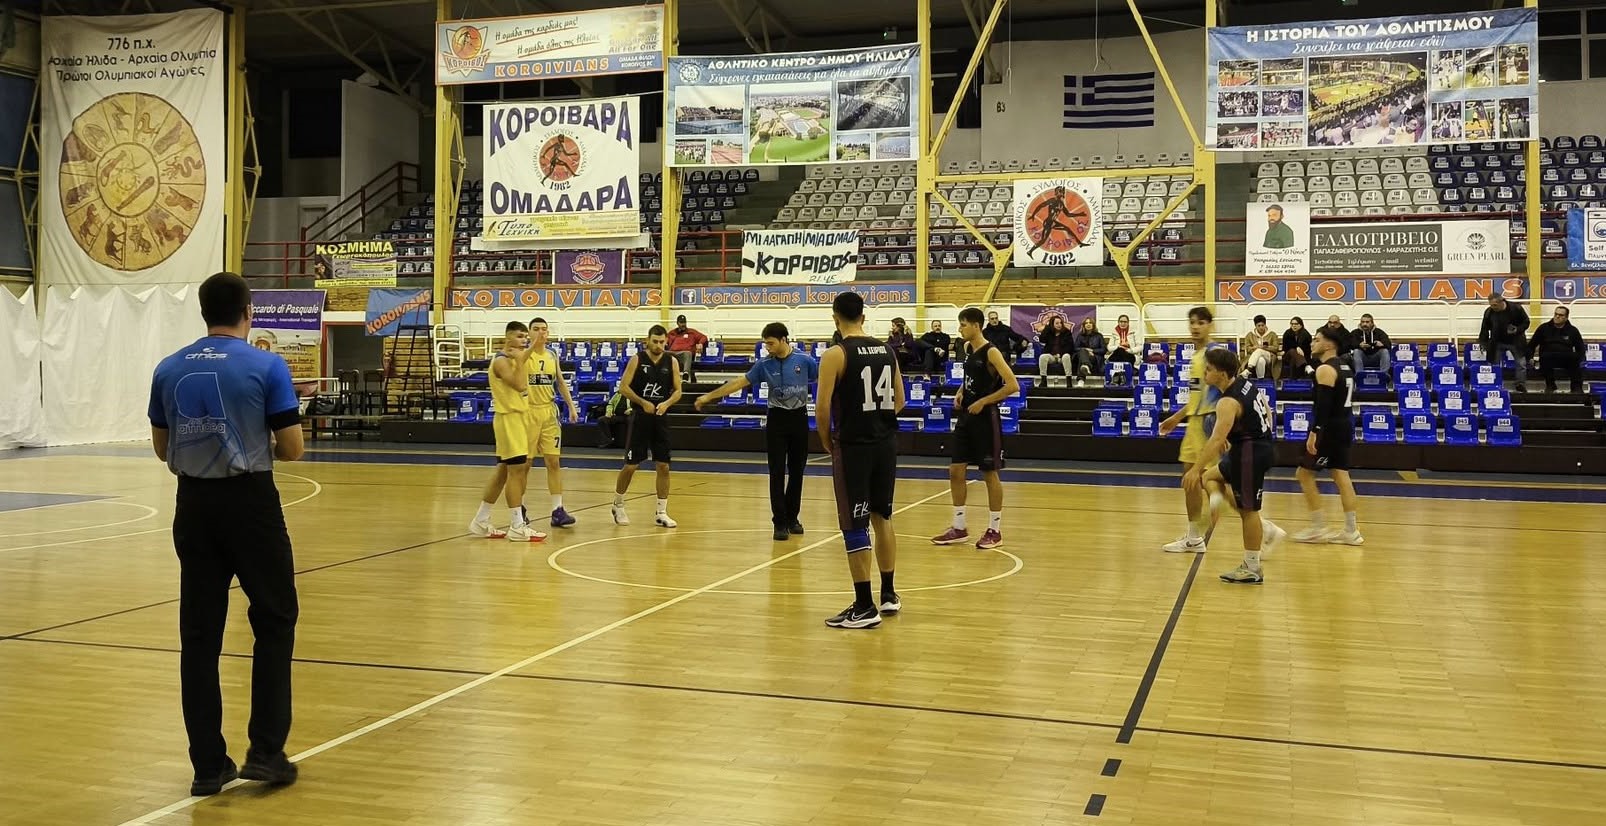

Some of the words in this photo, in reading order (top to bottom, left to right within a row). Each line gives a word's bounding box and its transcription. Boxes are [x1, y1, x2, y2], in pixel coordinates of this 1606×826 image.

[1246, 30, 1259, 43] Η
[1263, 26, 1330, 42] ΙΣΤΟΡΙΑ
[1335, 24, 1370, 38] ΤΟΥ
[1377, 15, 1495, 36] ΑΘΛΗΤΙΣΜΟΥ
[107, 38, 130, 50] 776
[1346, 42, 1364, 52] να
[128, 53, 168, 66] Αρχαία
[170, 48, 216, 62] Ολυμπία
[708, 59, 768, 71] ΑΘΛΗΤΙΚΟ
[771, 56, 816, 68] ΚΕΝΤΡΟ
[818, 54, 860, 65] ΔΗΜΟΥ
[866, 49, 911, 62] ΗΛΙΔΑΣ
[94, 67, 157, 82] Ολυμπιακοί
[494, 57, 610, 77] KOROIVIANS
[489, 101, 632, 158] ΚΟΡΟΙΒΑΡΑ
[550, 180, 572, 191] 1982
[490, 175, 633, 215] ΟΜΑΔΑΡΑ
[1314, 231, 1439, 247] ΕΛΑΙΟΤΡΙΒΕΙΟ
[316, 242, 394, 255] ΚΟΣΜΗΜΑ
[1040, 251, 1076, 266] 1982
[1447, 252, 1475, 261] GREEN
[1478, 252, 1506, 260] PEARL
[700, 286, 800, 304] koroivians
[806, 286, 910, 302] korvians
[1216, 278, 1523, 301] KOROIVIANS
[452, 289, 666, 308] KOROIVIANS
[286, 304, 319, 316] Pasquale
[538, 360, 545, 371] 7
[860, 364, 894, 412] 14
[554, 436, 560, 448] 7
[628, 450, 632, 460] 4
